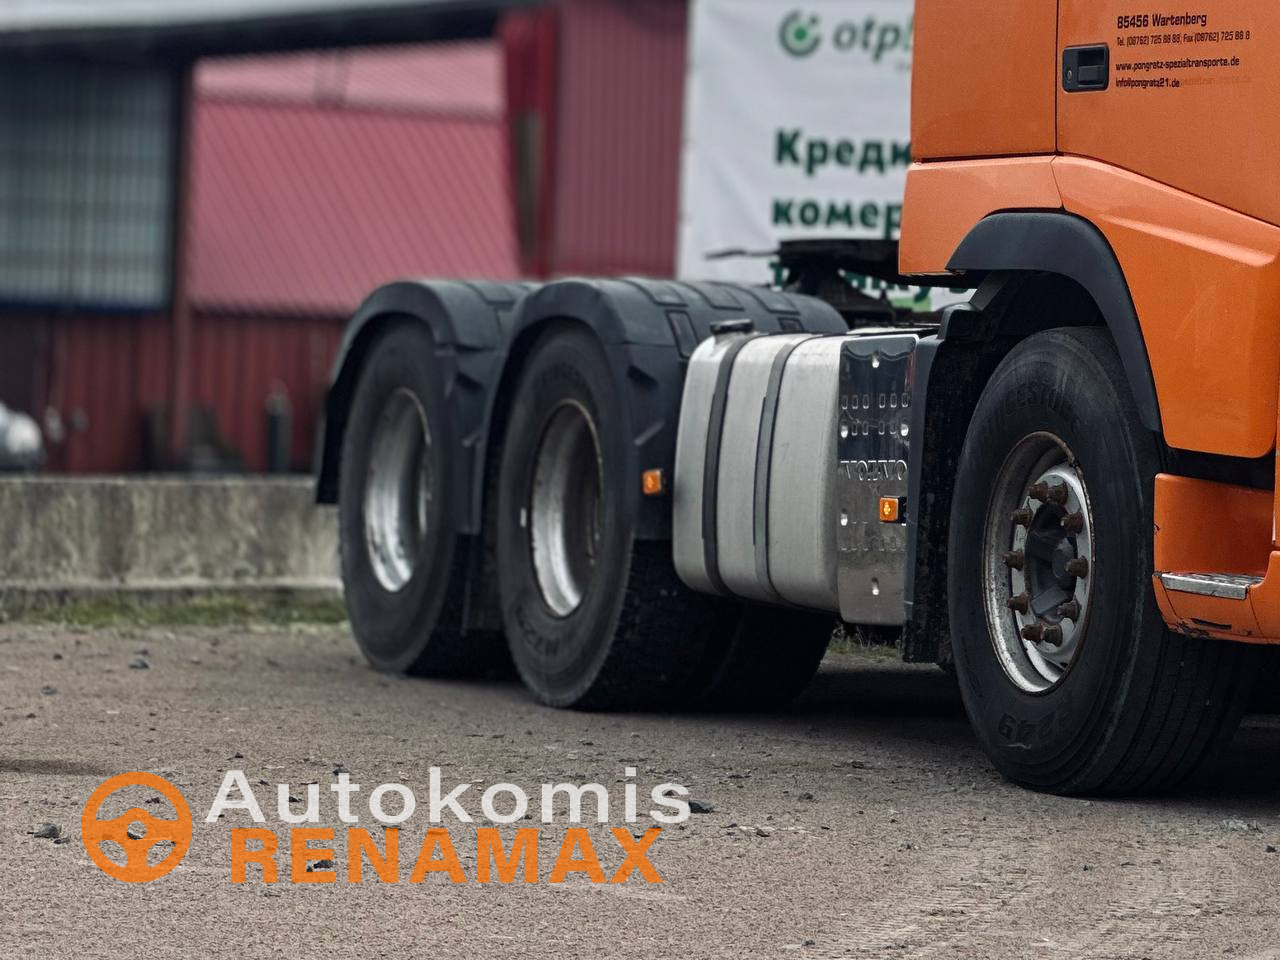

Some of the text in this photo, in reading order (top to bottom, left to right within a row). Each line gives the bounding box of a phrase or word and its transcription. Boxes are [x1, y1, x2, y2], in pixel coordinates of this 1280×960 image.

[1117, 12, 1207, 29] 85456 Wartenberg
[1221, 31, 1233, 40] 725
[1116, 56, 1239, 72] www.pongratz-spezialtransporte.de
